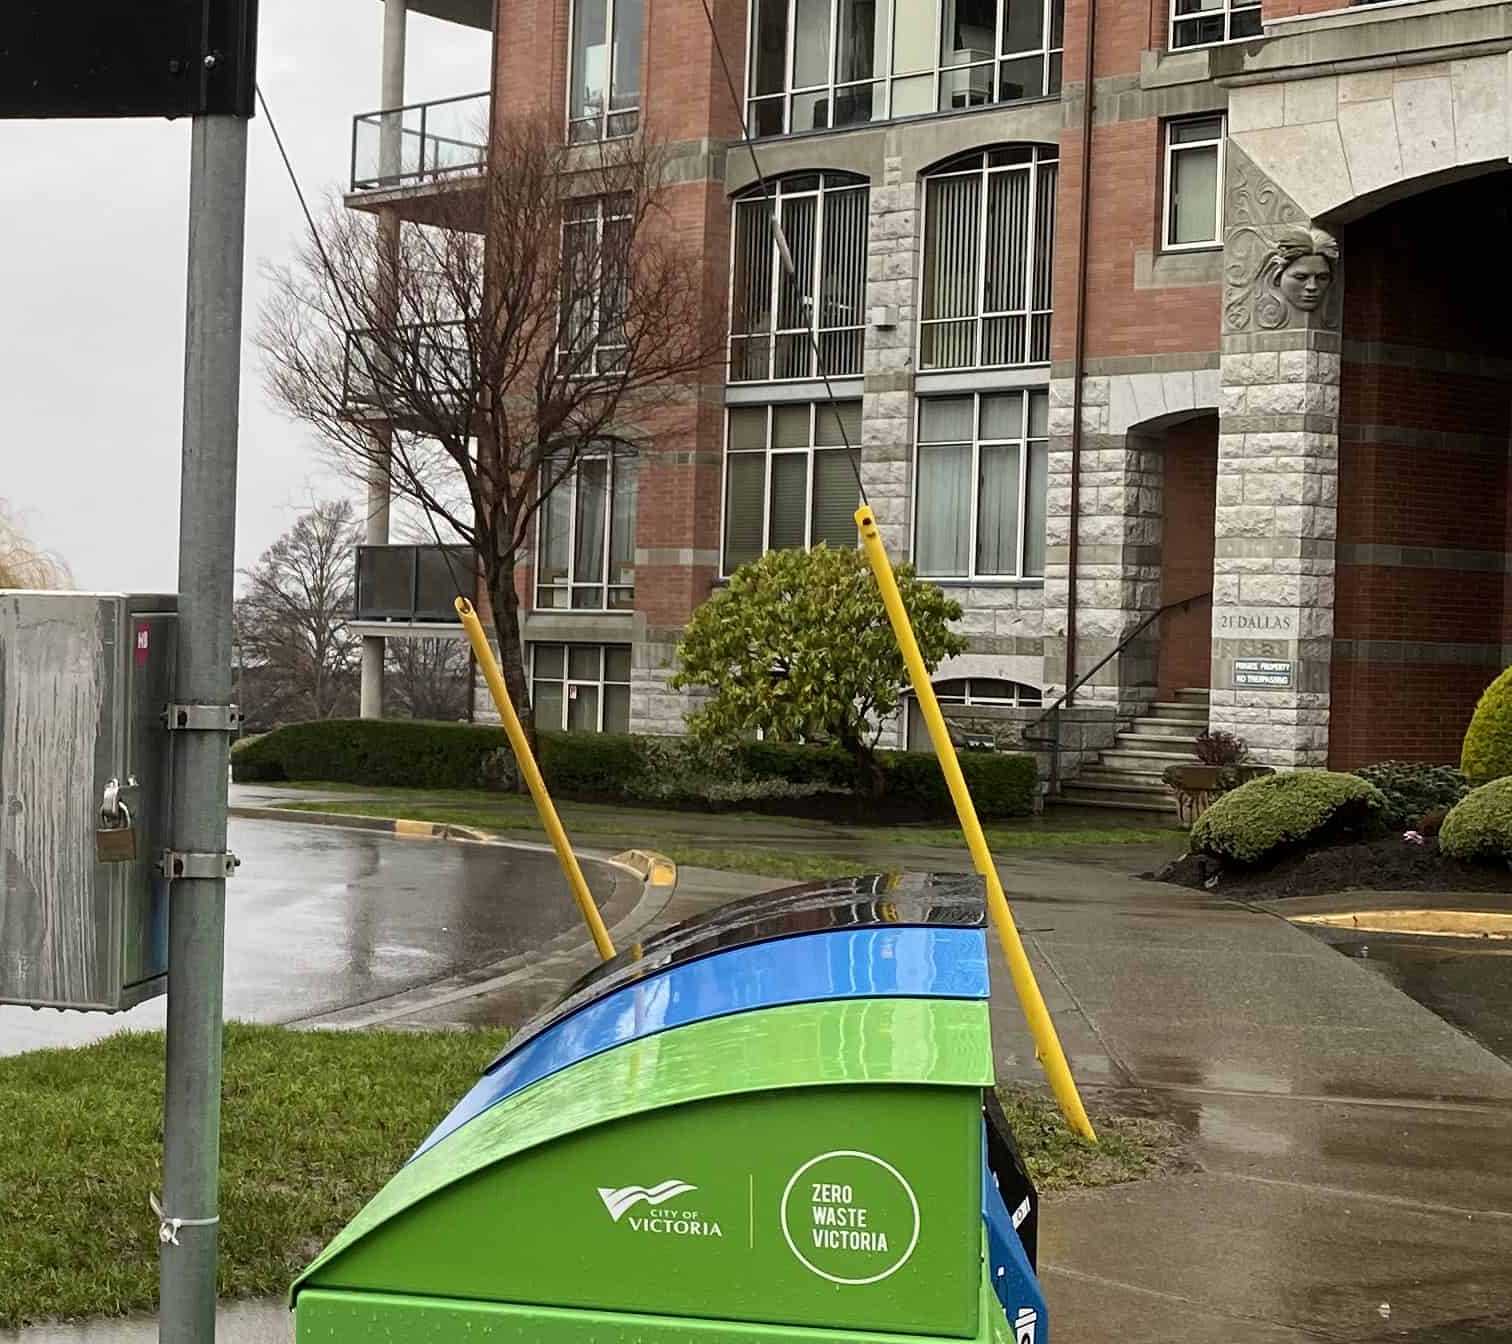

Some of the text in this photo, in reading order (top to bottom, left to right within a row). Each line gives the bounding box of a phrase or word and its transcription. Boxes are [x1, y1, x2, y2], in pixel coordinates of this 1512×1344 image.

[1238, 615, 1290, 629] DALLAS
[812, 1183, 853, 1205] ZERO
[650, 1209, 698, 1220] CITY OF
[812, 1206, 867, 1229] WASTE
[628, 1217, 723, 1237] VICTORIA
[812, 1229, 889, 1253] VICTORIA
